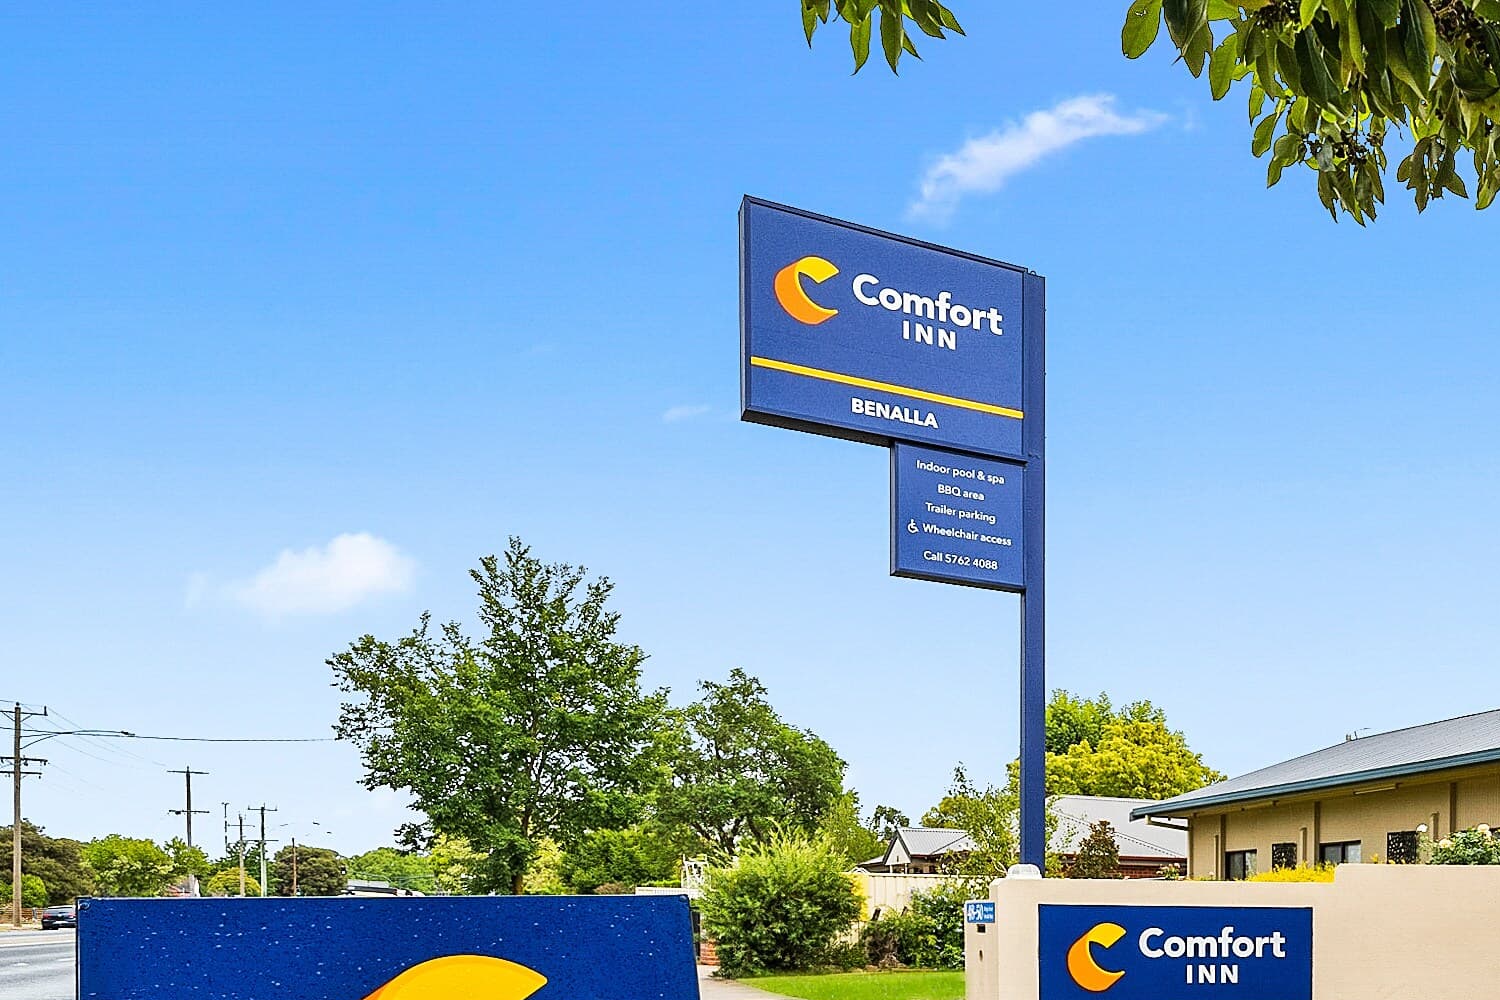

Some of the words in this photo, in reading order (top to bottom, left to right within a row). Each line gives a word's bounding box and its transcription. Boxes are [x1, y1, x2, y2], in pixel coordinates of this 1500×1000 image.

[852, 273, 1003, 336] Comfort
[902, 320, 957, 351] INN
[851, 397, 939, 429] BENALLA
[916, 459, 950, 474] Indoor
[952, 468, 975, 479] pool
[977, 470, 986, 481] &
[987, 474, 1005, 485] spa
[937, 483, 961, 497] BBQ
[963, 490, 985, 501] area
[925, 502, 956, 516] Trailer
[958, 509, 996, 525] parking
[922, 523, 979, 541] Wheelchair
[980, 534, 1012, 546] access
[923, 550, 943, 562] Call
[944, 555, 971, 567] 5762
[972, 558, 998, 570] 4088
[1138, 926, 1286, 959] Comfort
[1186, 964, 1239, 984] INN
